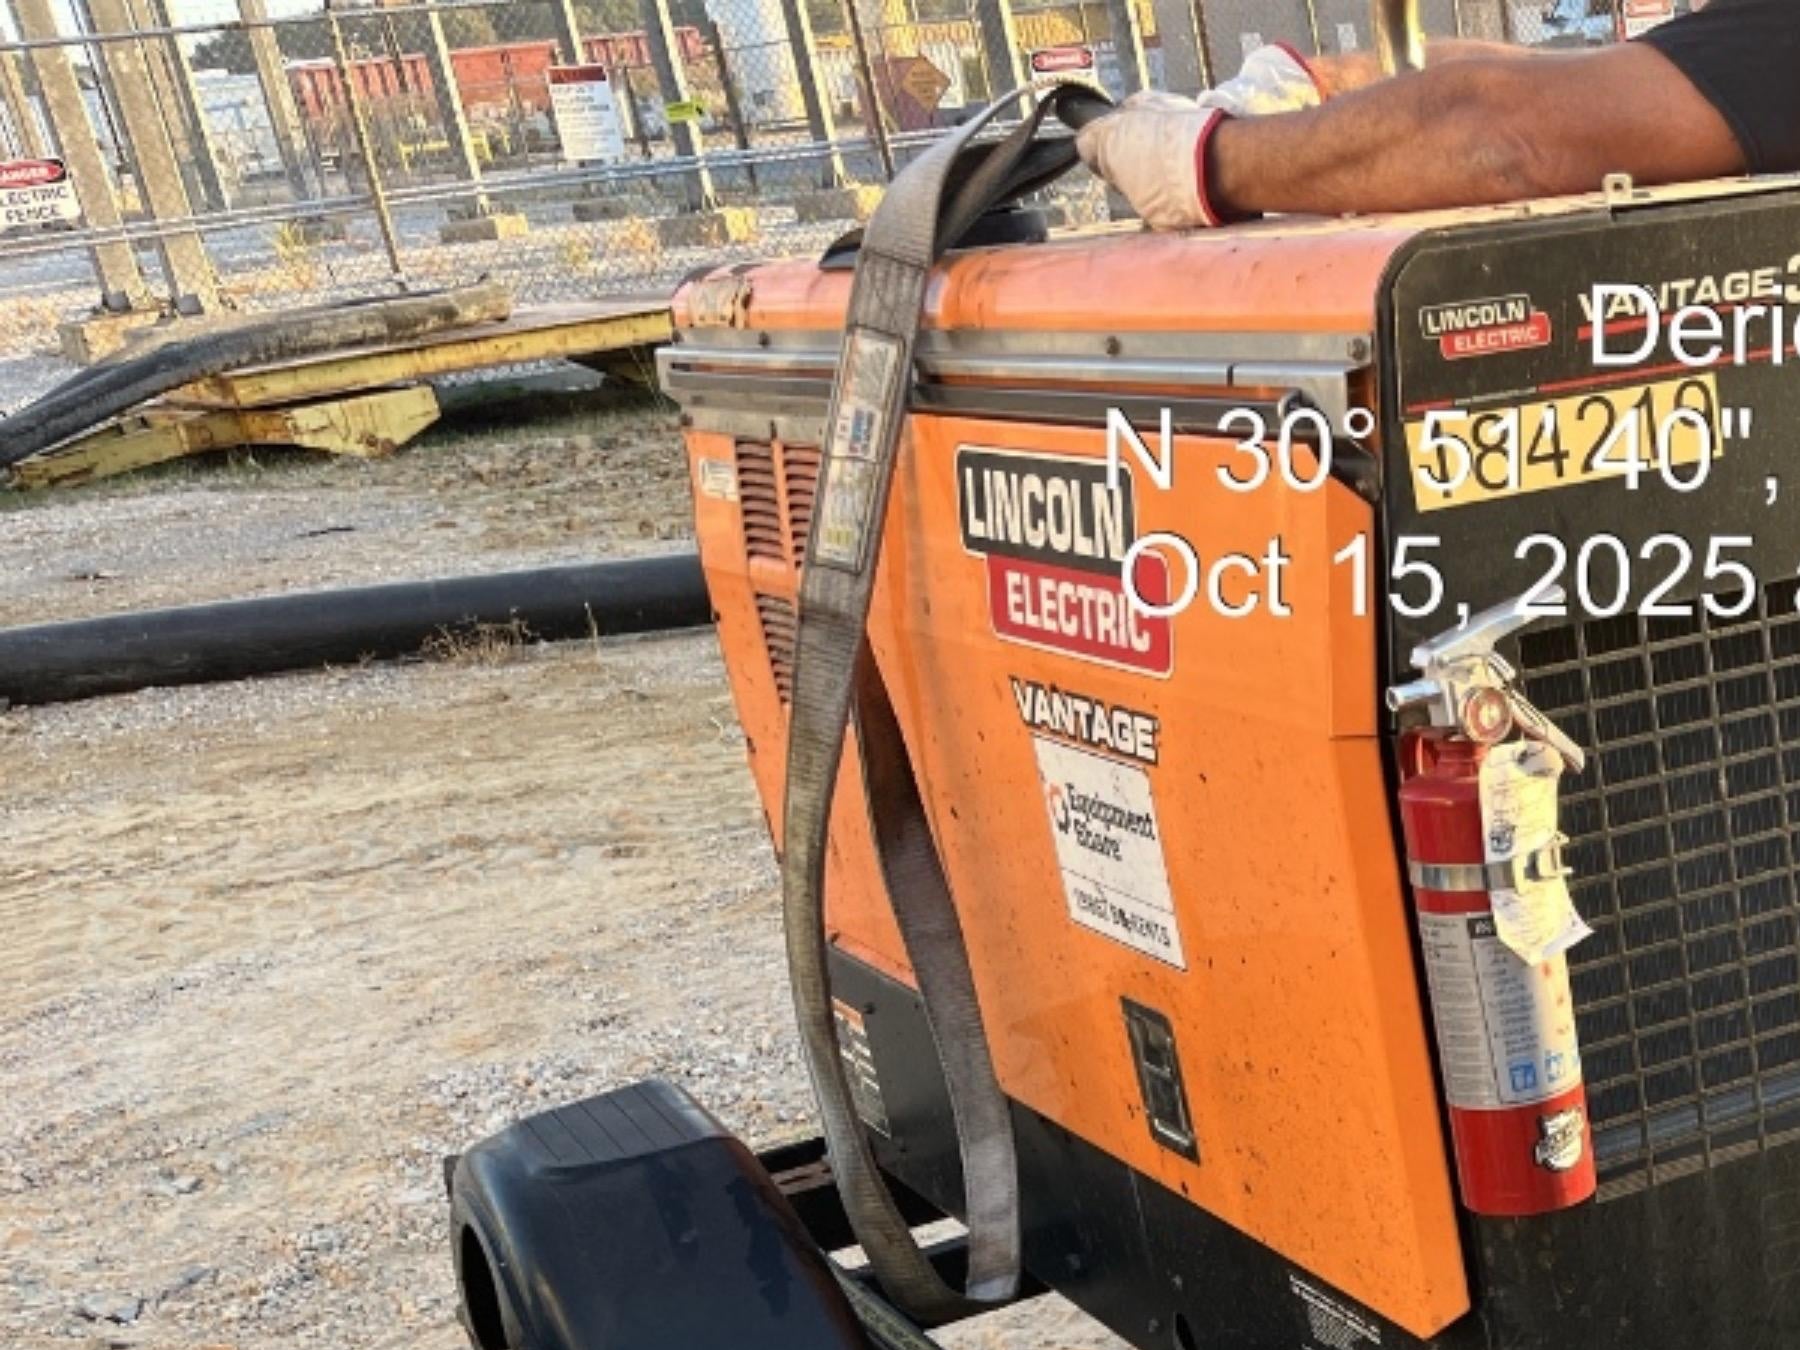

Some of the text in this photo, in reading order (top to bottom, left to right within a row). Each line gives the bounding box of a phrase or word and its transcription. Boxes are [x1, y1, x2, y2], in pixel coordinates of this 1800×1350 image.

[1426, 299, 1526, 334] LINCOLN
[1577, 266, 1781, 321] VANTAGE
[1453, 326, 1540, 352] ELECTRIC
[964, 466, 1126, 562] LINCOLN
[1004, 570, 1151, 653] ELECTRIC
[1010, 676, 1159, 765] VANTAGE
[1065, 782, 1156, 841] Equipment
